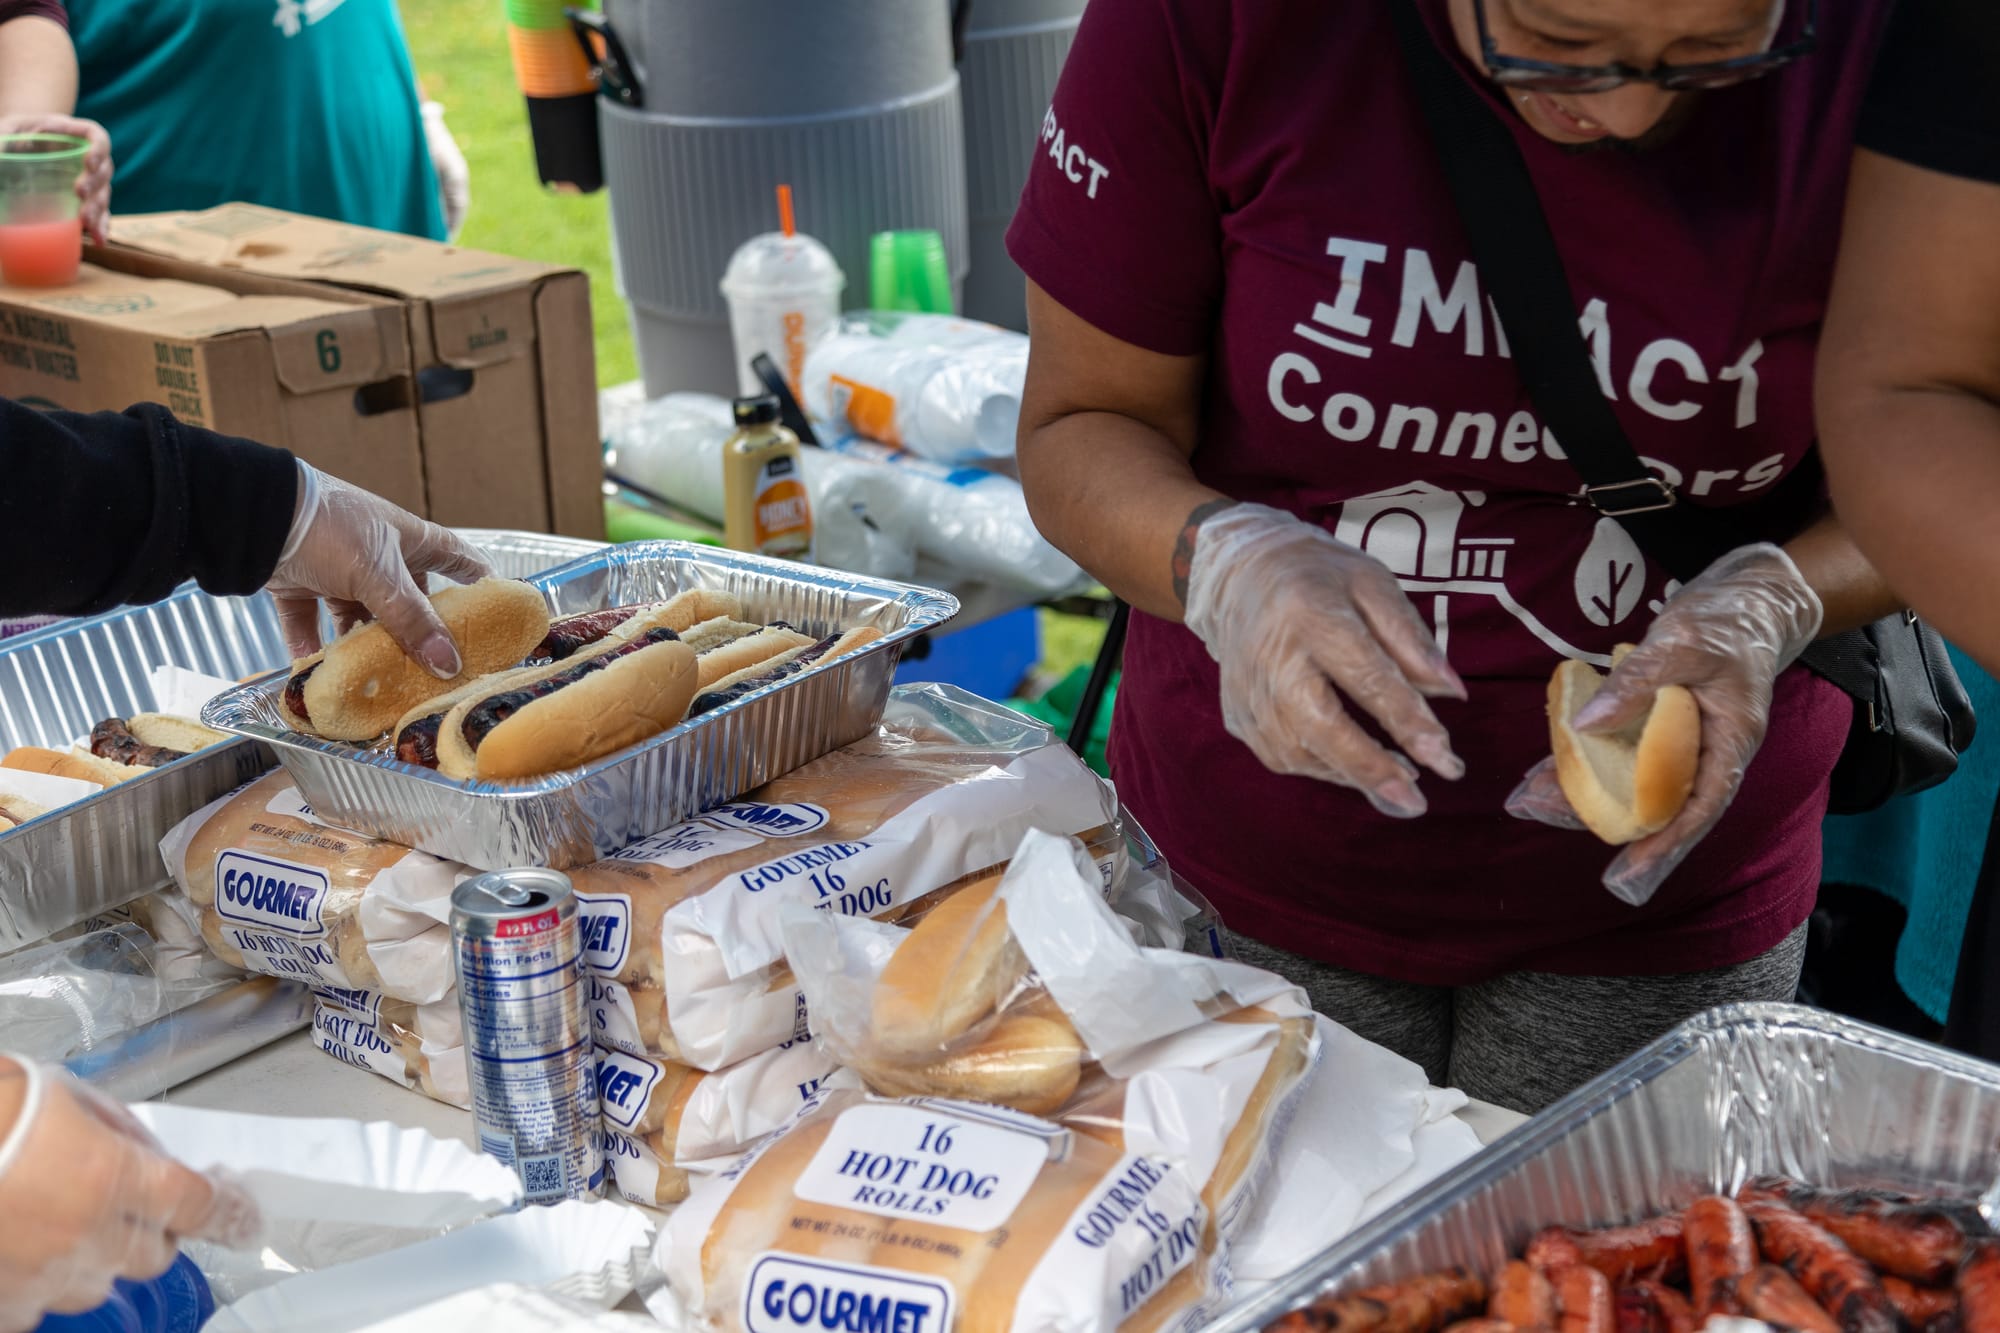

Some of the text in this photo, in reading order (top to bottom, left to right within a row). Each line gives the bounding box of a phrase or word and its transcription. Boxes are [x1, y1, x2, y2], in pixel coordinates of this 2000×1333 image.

[1041, 104, 1109, 199] PACT
[316, 329, 342, 374] 6
[1312, 237, 1764, 428] IMACT
[223, 869, 318, 922] GOURMET
[807, 864, 847, 899] 16
[233, 929, 258, 951] 16
[254, 934, 295, 956] HOT
[505, 924, 520, 936] 12
[521, 921, 536, 935] FL
[462, 950, 552, 967] Nutrition Facts
[464, 982, 511, 998] Calories
[916, 1121, 962, 1156] 16
[836, 1149, 1000, 1202] HOT DOG
[852, 1184, 951, 1217] ROLLS
[1074, 1156, 1172, 1249] GOURME
[1135, 1202, 1171, 1245] 16
[1120, 1246, 1165, 1313] HOT
[763, 1279, 930, 1333] GOURMET
